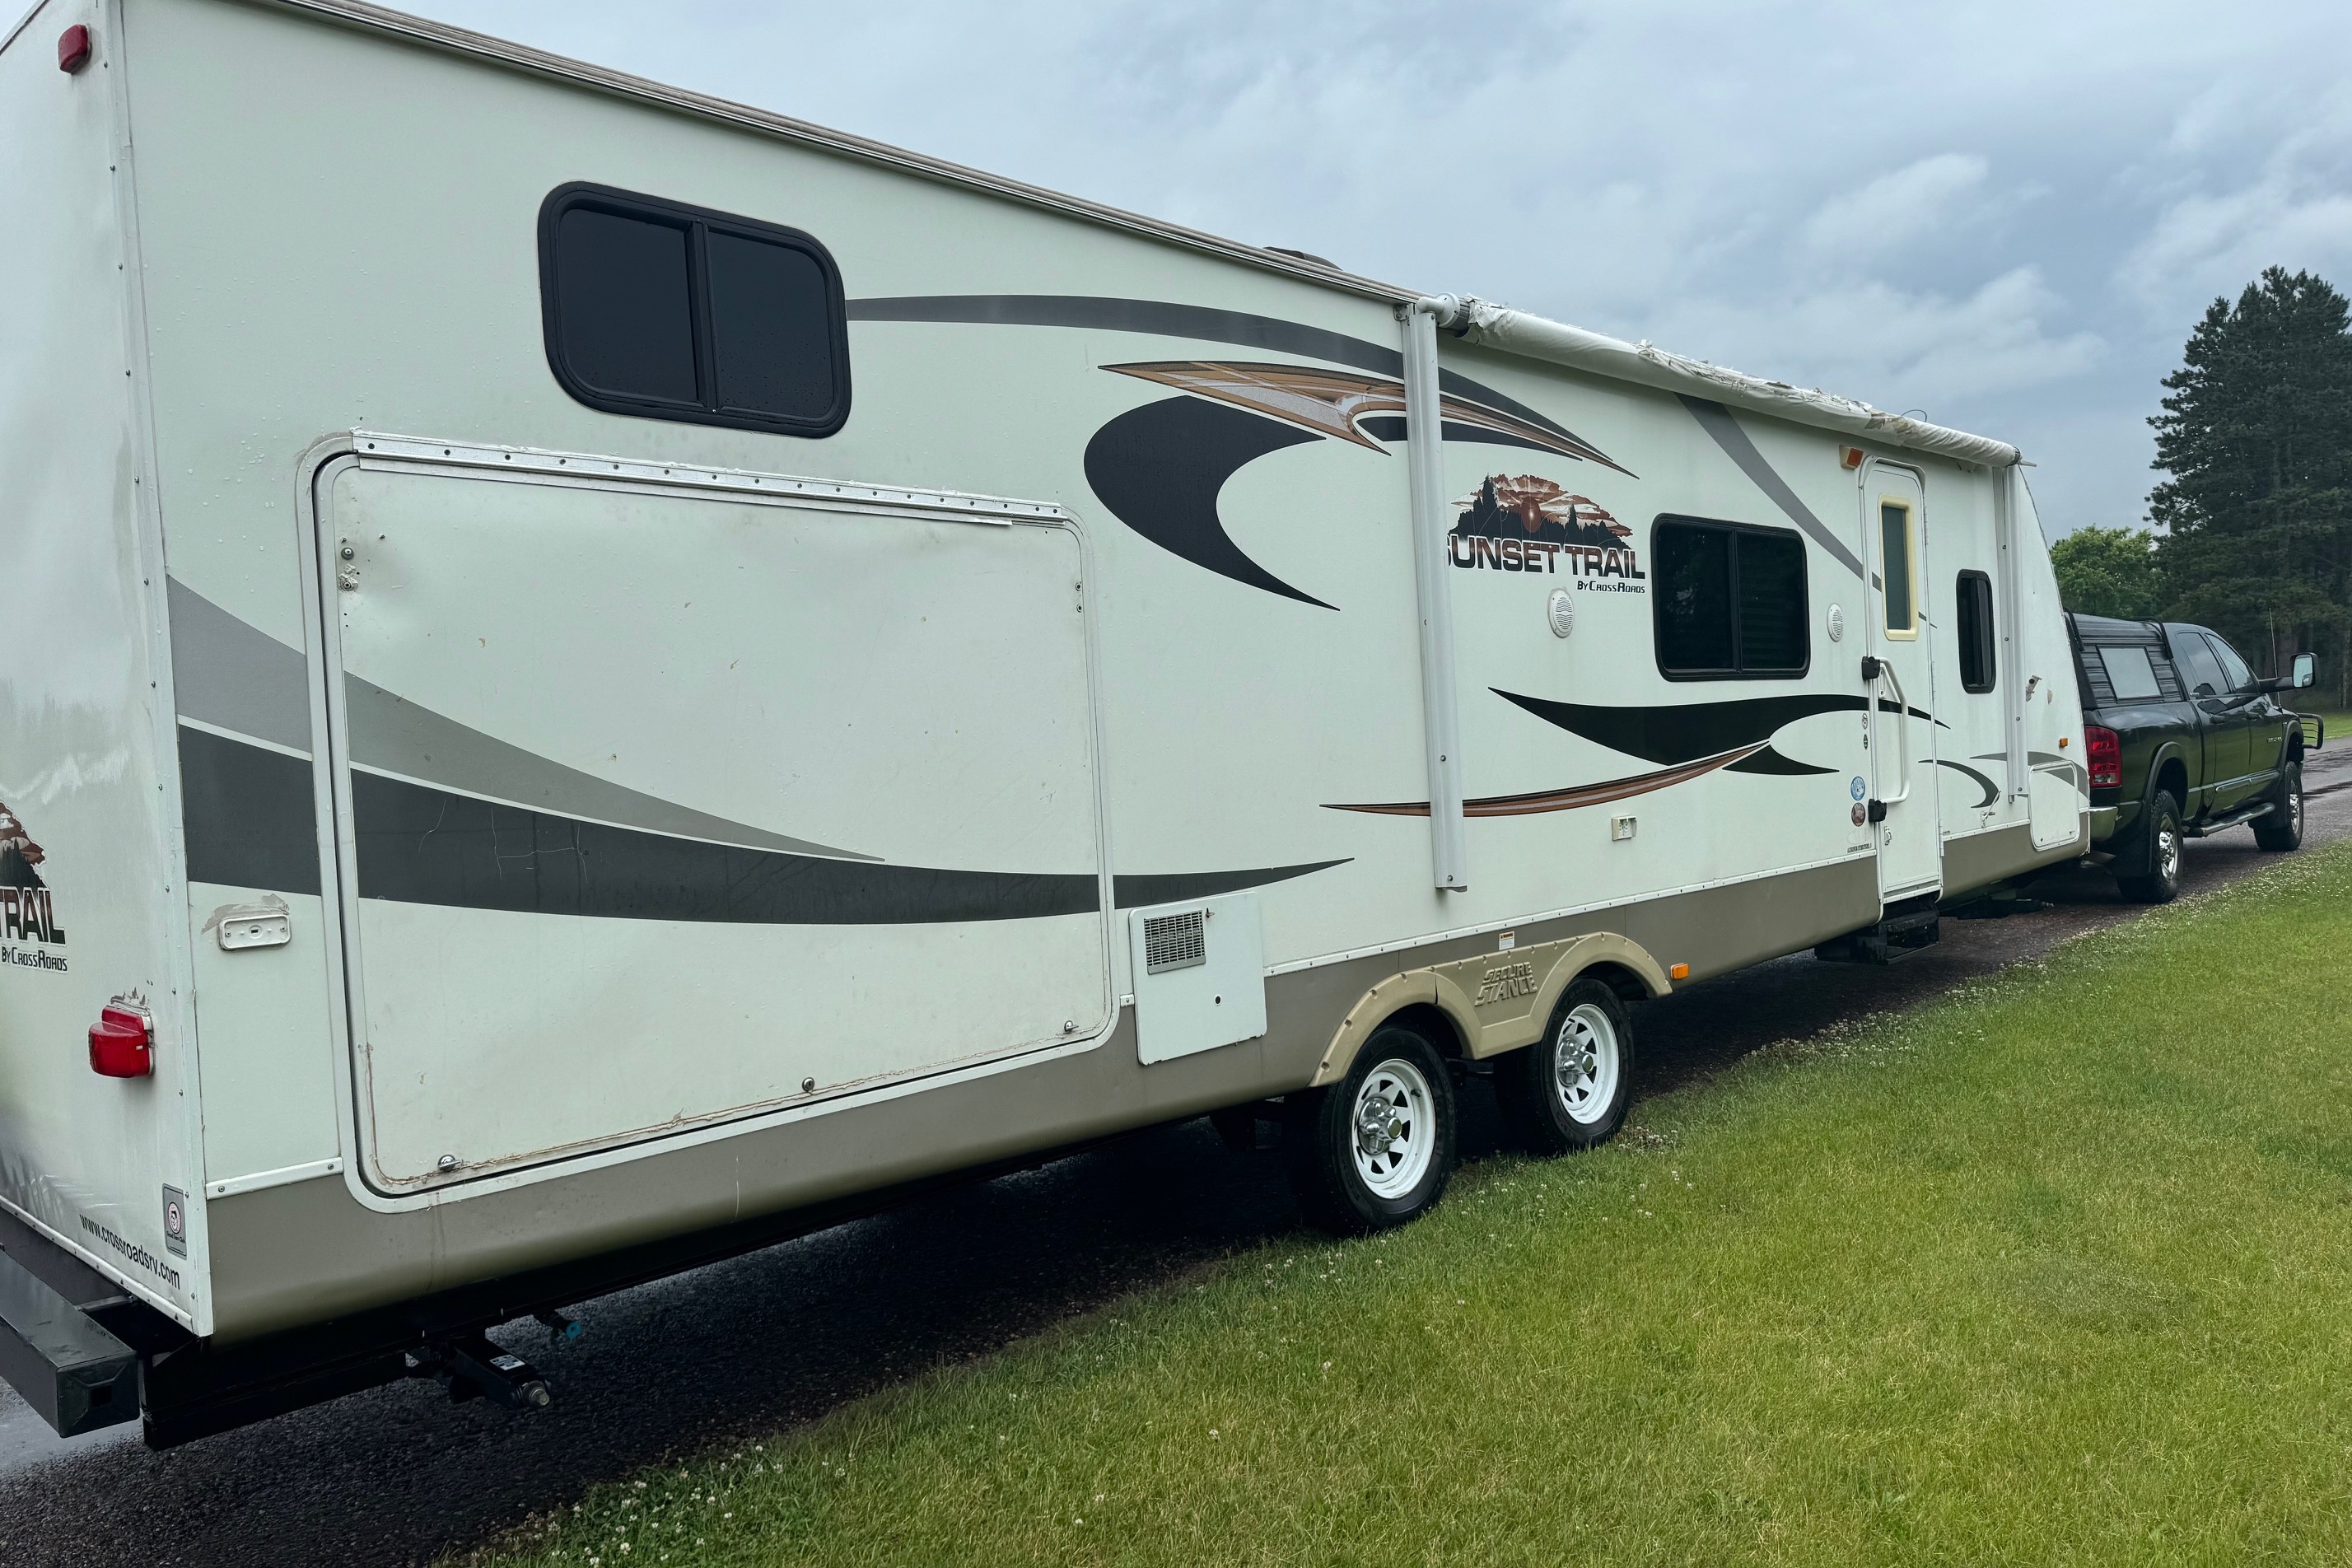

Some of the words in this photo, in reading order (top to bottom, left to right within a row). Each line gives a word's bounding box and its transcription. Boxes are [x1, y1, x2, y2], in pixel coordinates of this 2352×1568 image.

[1447, 534, 1561, 574] UNSET
[1565, 544, 1646, 580] TRAIL
[1474, 975, 1538, 1007] STANCE
[1482, 961, 1533, 984] SECURE
[79, 1214, 180, 1290] www.crossroadsrv.com
